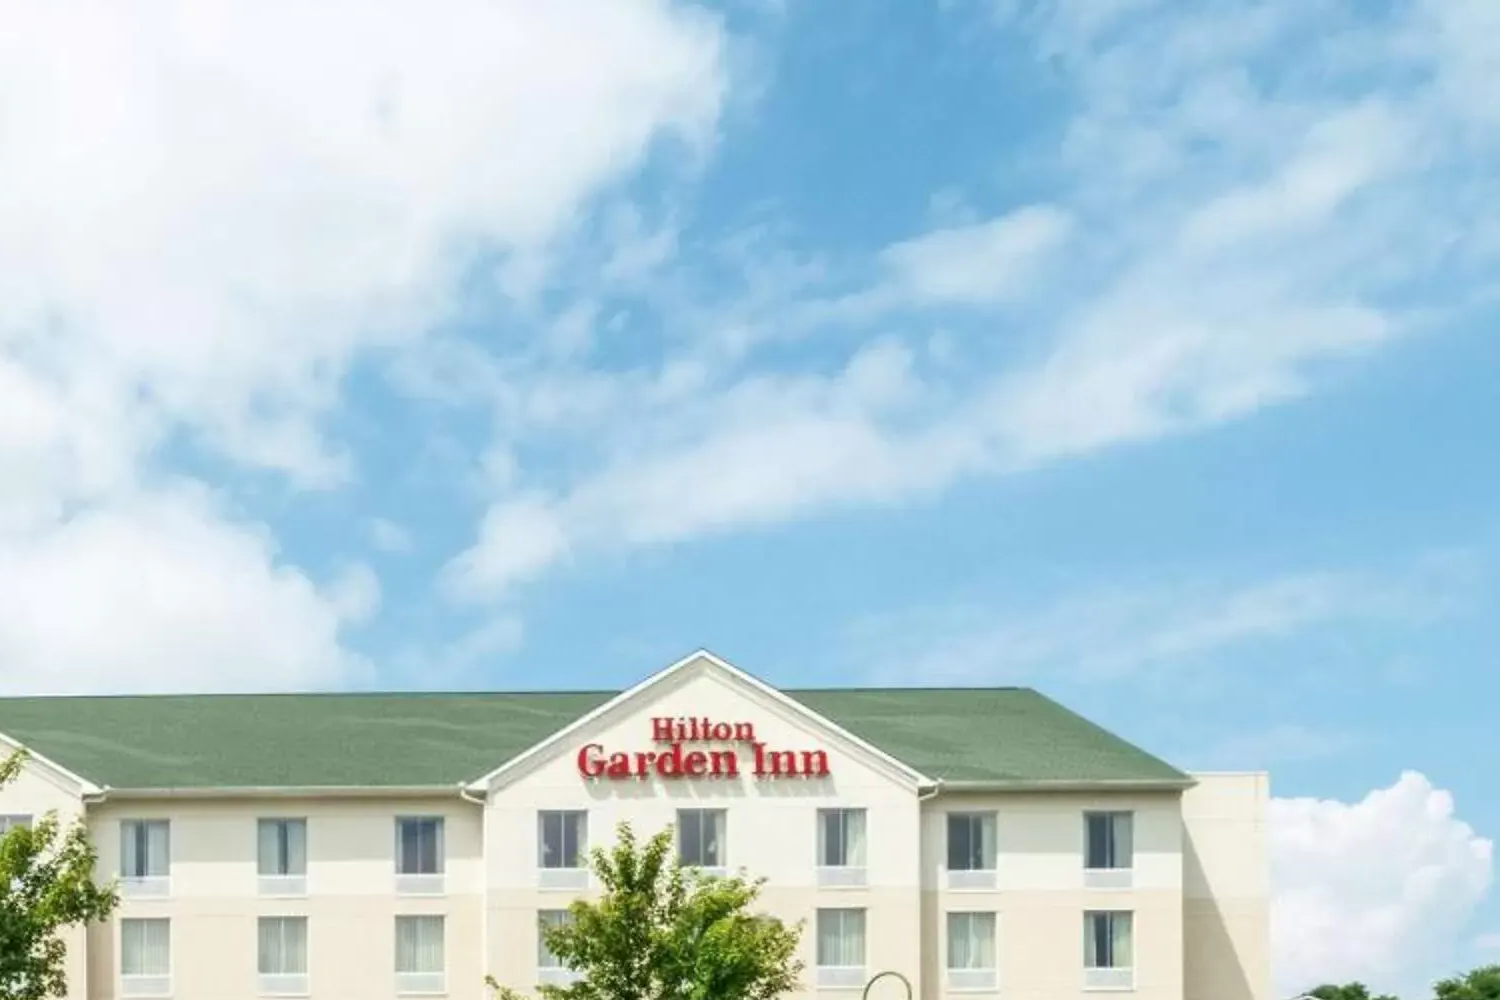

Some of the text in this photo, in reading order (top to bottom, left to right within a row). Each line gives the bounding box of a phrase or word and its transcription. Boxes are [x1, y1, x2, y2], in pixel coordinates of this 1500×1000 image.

[651, 717, 756, 743] Hilton
[577, 742, 830, 778] Garden Inn
